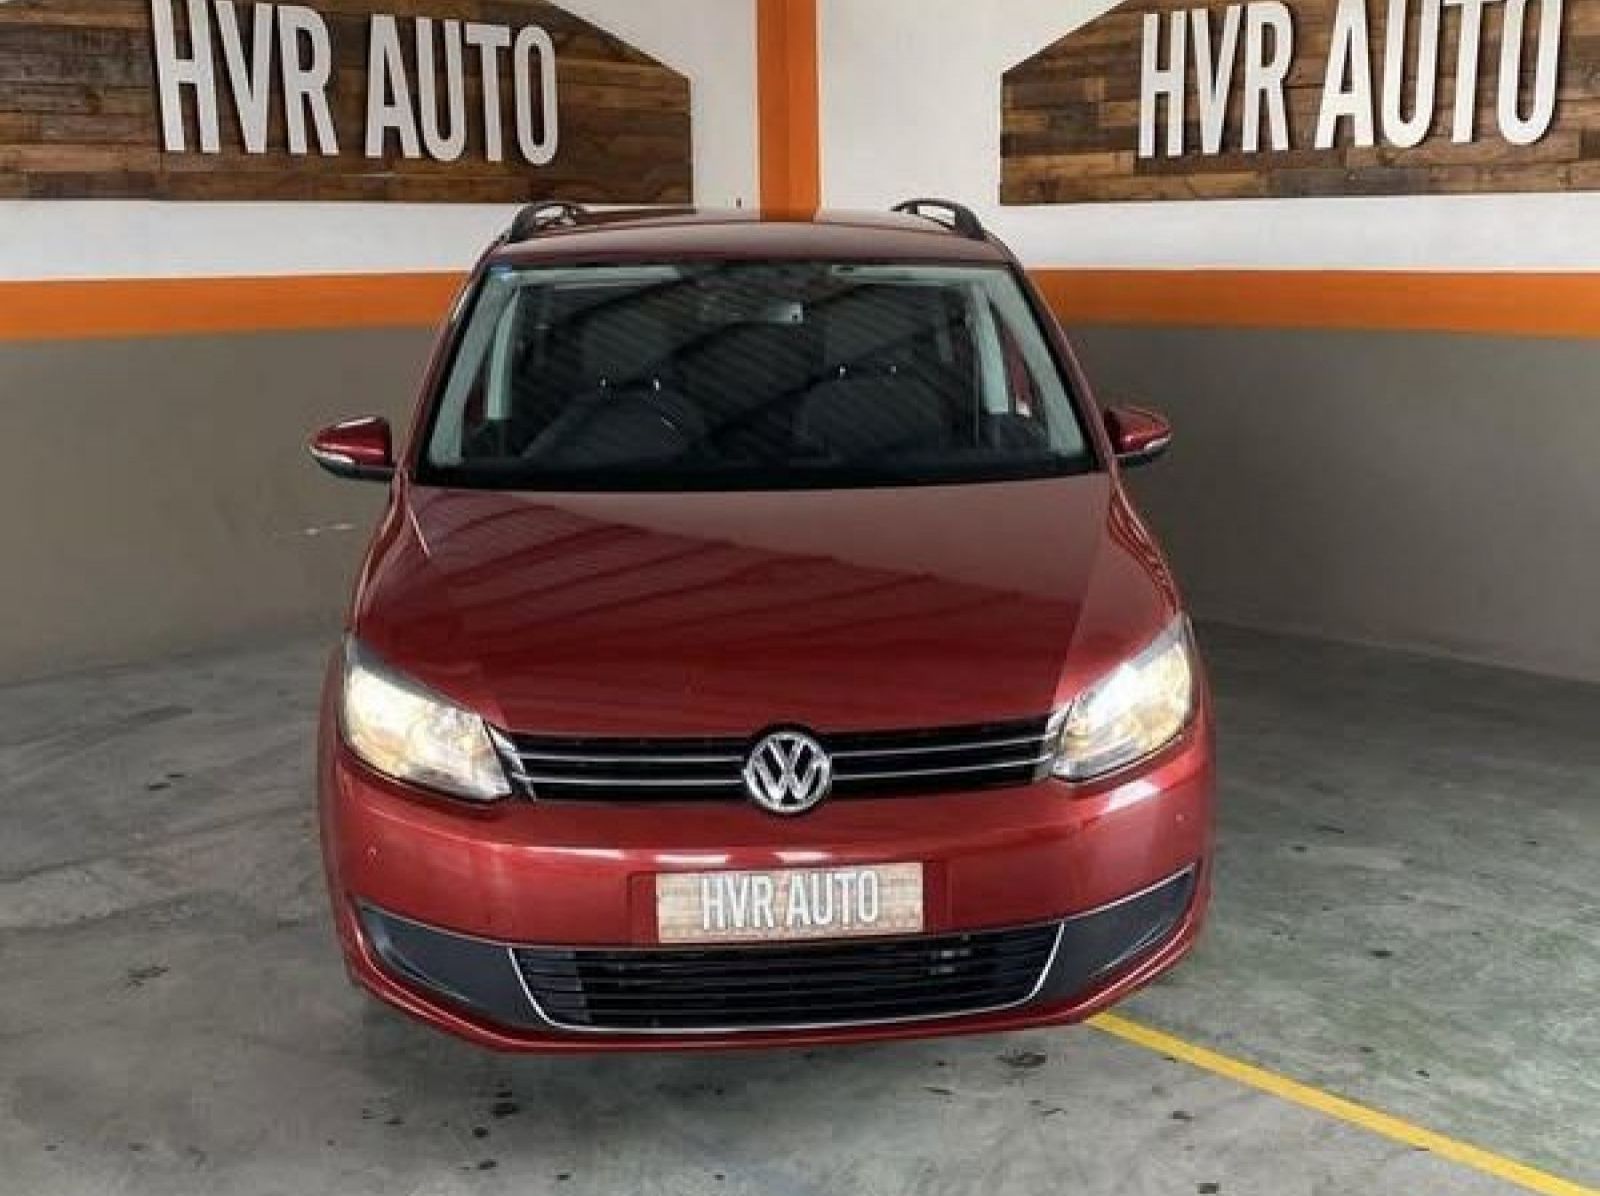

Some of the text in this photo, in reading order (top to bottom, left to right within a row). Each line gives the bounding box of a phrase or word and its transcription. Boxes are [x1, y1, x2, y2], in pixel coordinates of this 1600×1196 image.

[152, 0, 559, 165] HVR AUTO
[1138, 0, 1561, 158] HVR AUTO
[703, 870, 879, 930] HVR AUTO
